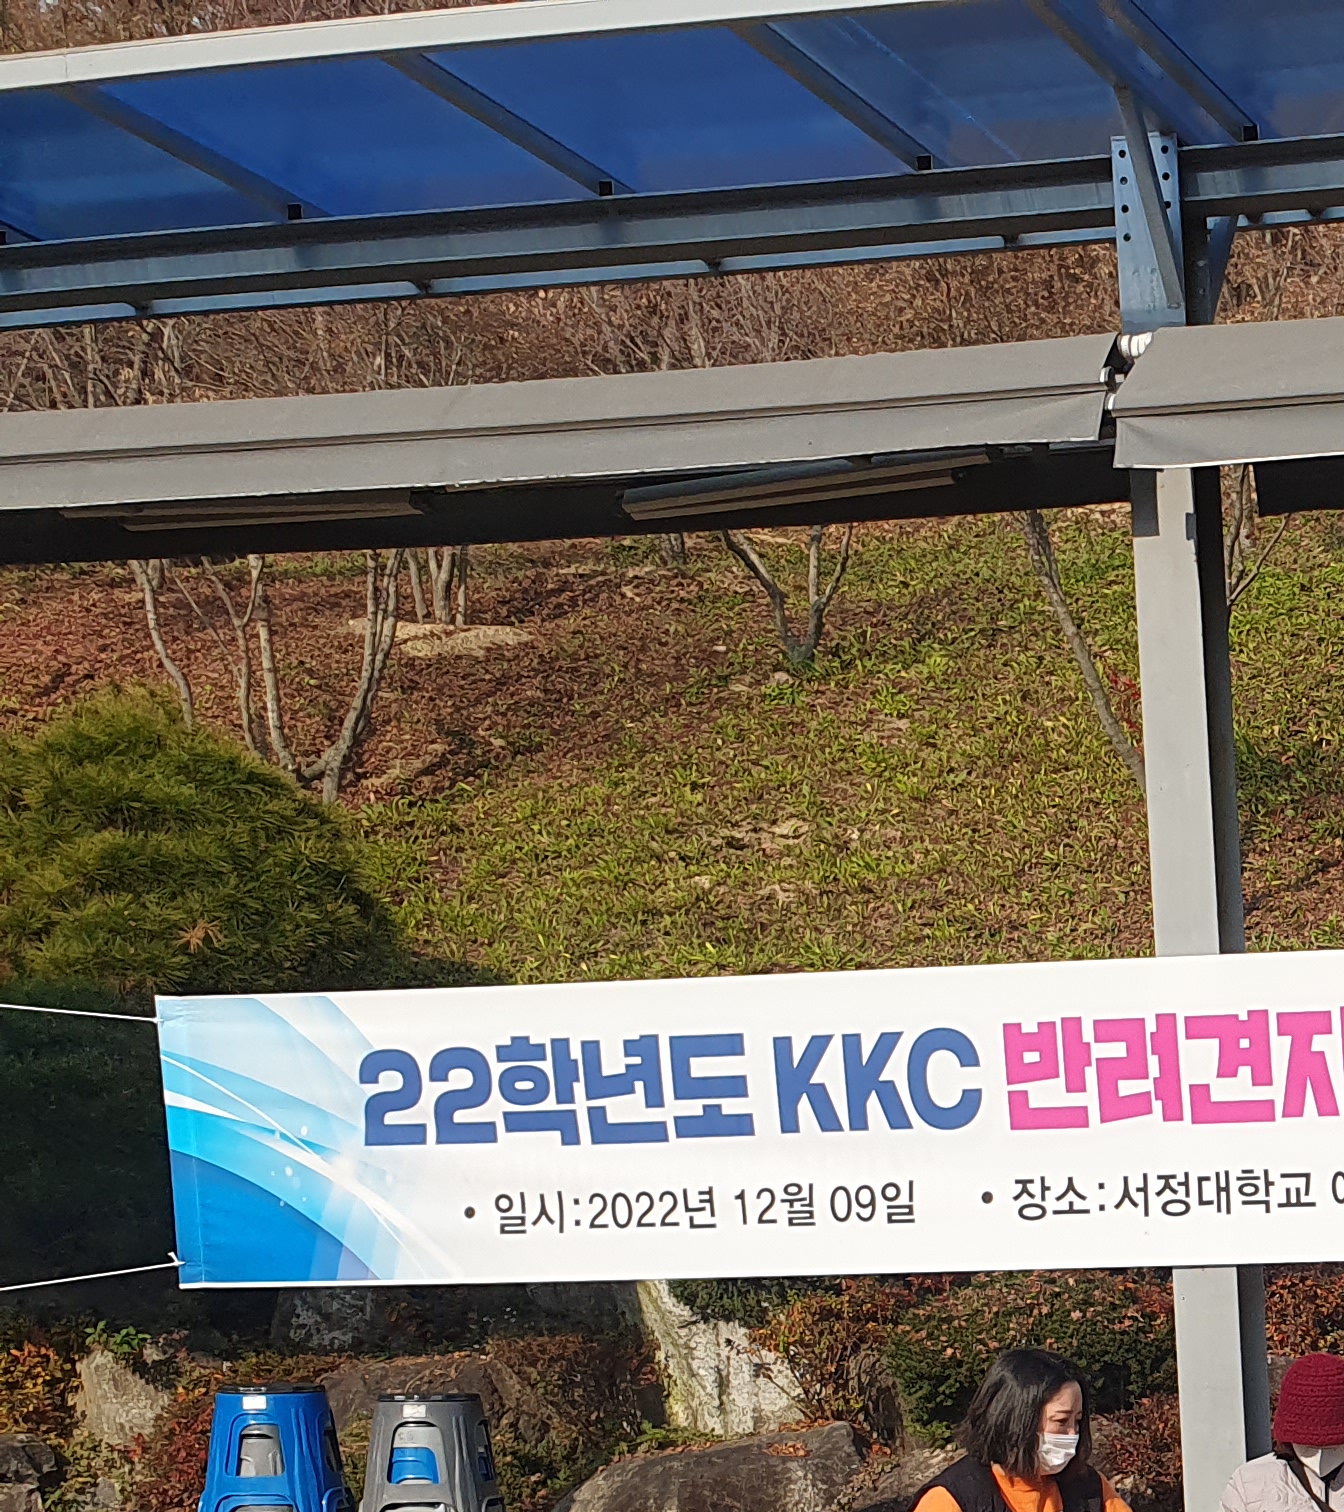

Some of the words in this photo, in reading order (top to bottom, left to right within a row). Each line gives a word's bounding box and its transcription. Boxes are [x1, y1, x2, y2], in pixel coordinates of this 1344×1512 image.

[358, 1033, 755, 1147] 22학년도
[772, 1027, 983, 1134] KKC
[733, 1182, 817, 1228] 12월
[829, 1180, 916, 1225] 09일
